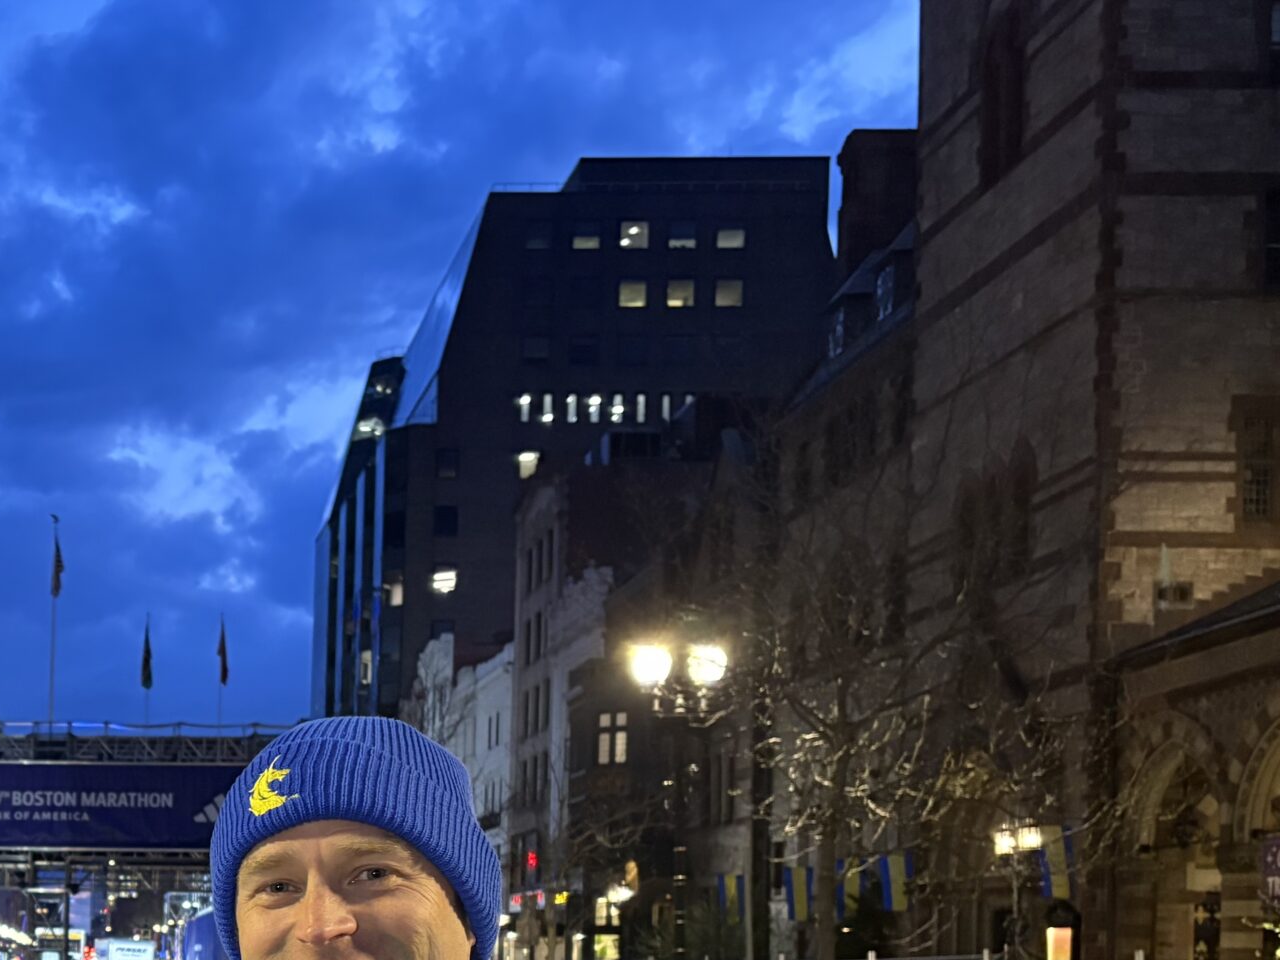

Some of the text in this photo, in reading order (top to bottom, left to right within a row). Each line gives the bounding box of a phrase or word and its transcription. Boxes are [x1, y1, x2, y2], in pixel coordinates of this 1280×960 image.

[12, 790, 76, 807] BOSTON
[81, 791, 174, 808] MARATHON
[14, 811, 30, 821] OF
[32, 811, 90, 822] AMERICA
